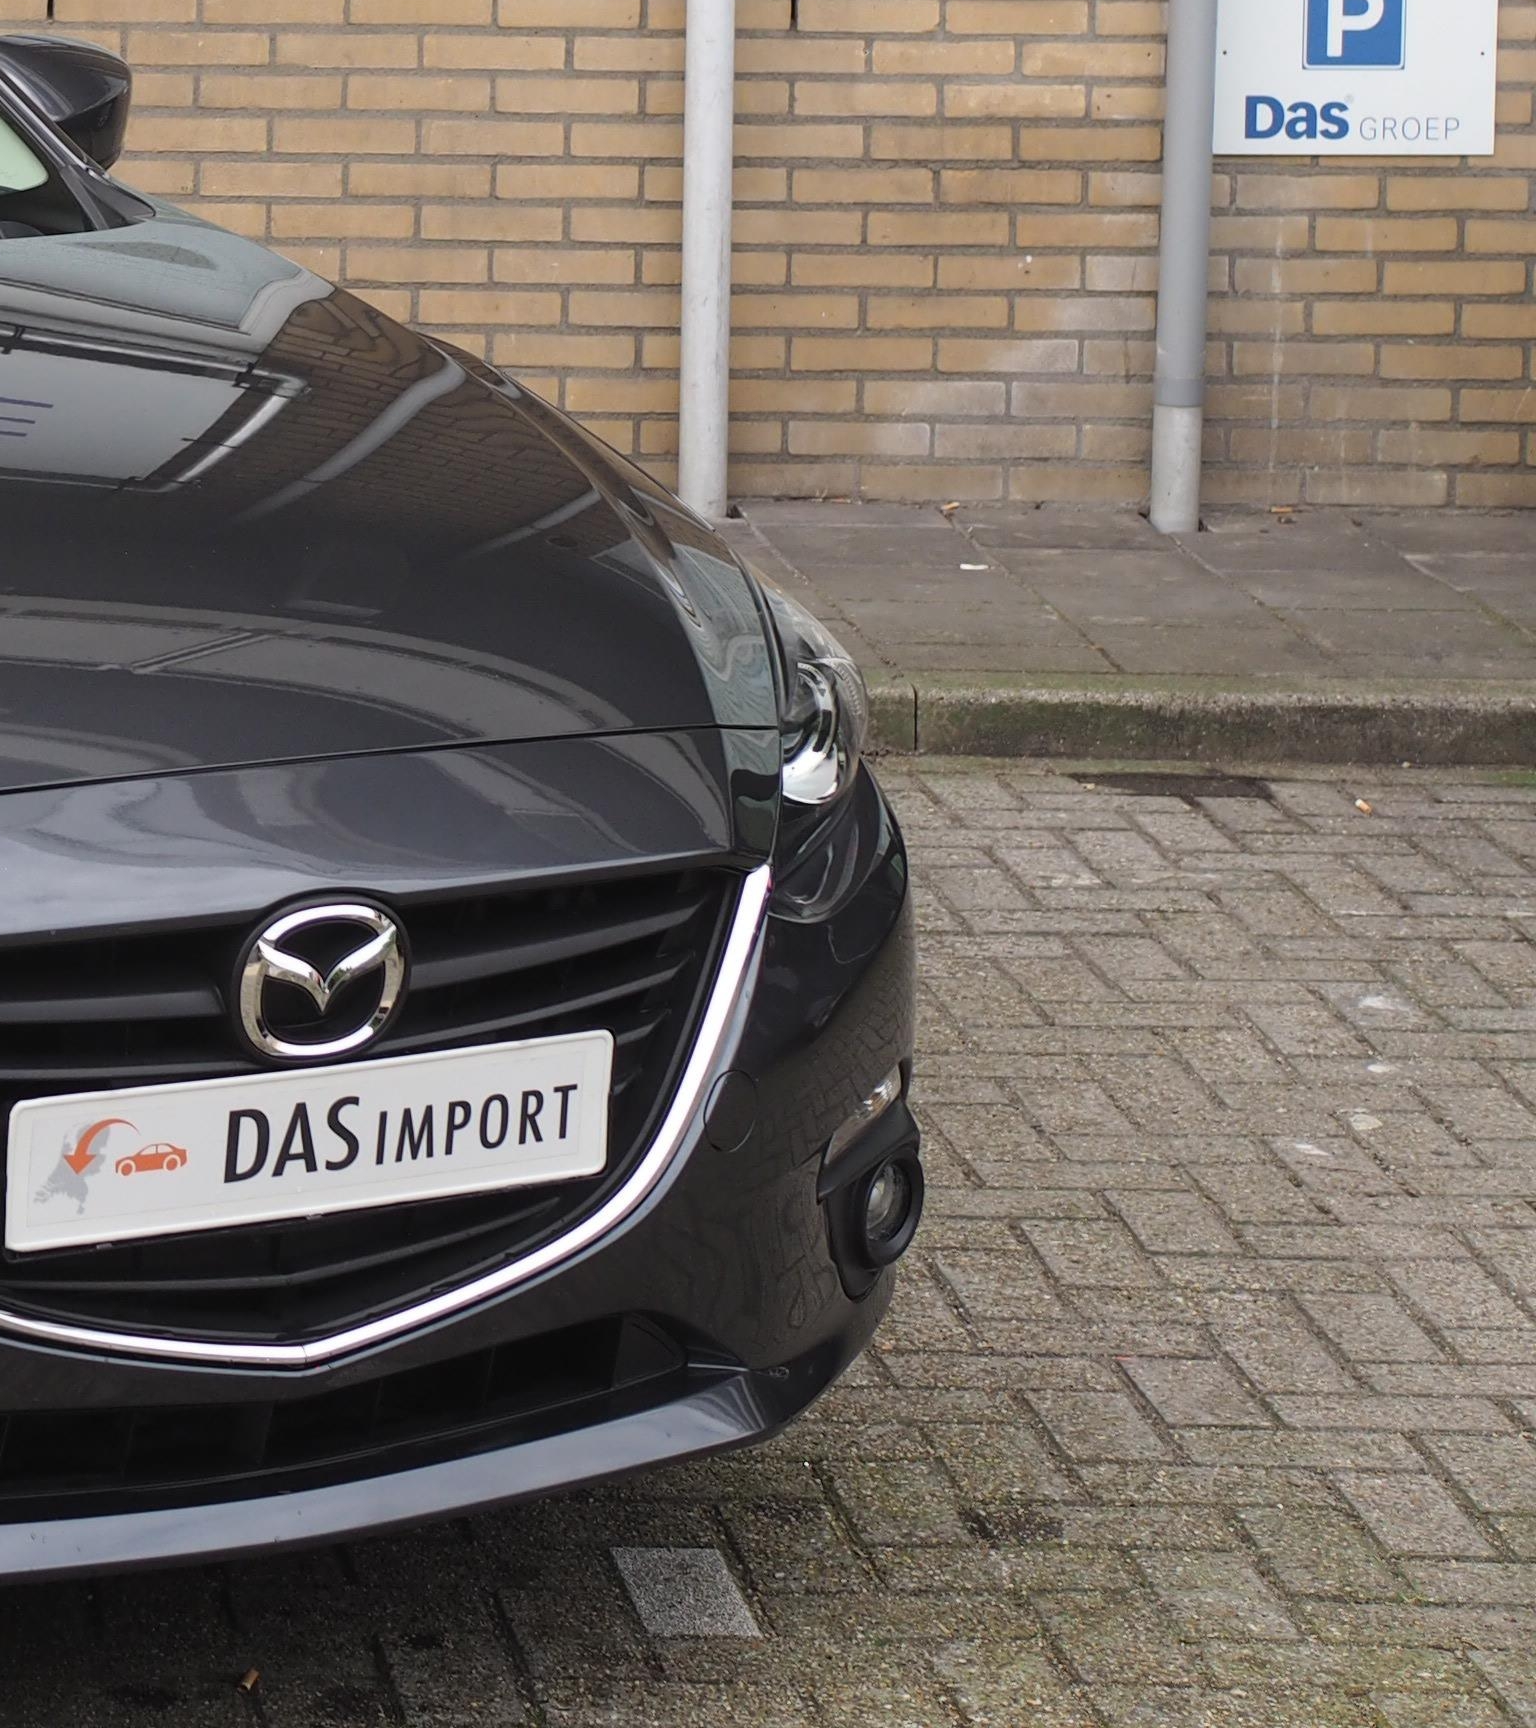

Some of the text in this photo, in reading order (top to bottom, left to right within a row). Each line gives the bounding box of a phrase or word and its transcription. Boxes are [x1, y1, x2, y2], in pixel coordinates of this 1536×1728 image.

[1244, 95, 1461, 141] Das GROEP
[224, 1083, 578, 1184] DAS IMPORT
